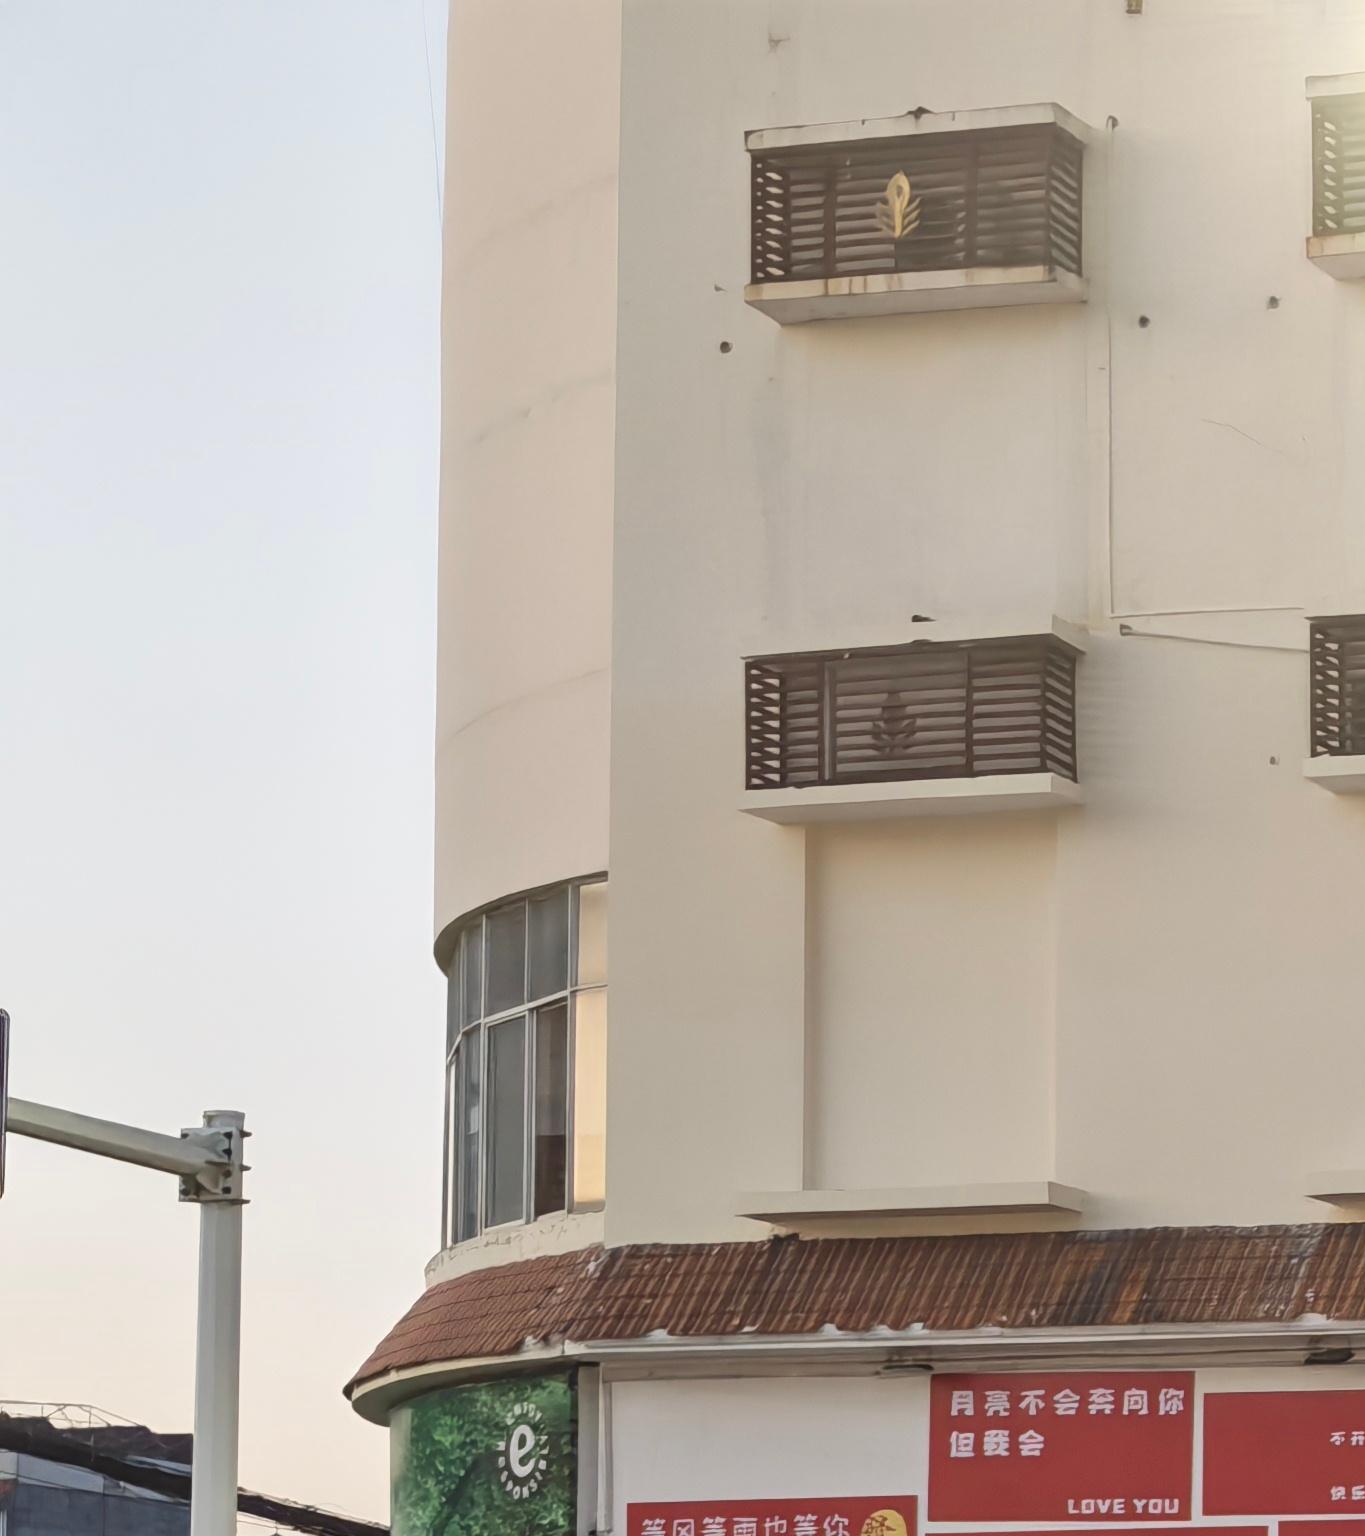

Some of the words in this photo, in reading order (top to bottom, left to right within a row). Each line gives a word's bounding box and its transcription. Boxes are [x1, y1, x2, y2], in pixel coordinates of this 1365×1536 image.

[951, 1388, 1184, 1416] 月亮不会奔向你
[950, 1430, 1044, 1457] 但我会
[1067, 1498, 1126, 1514] LOVE
[1132, 1498, 1179, 1514] YOU
